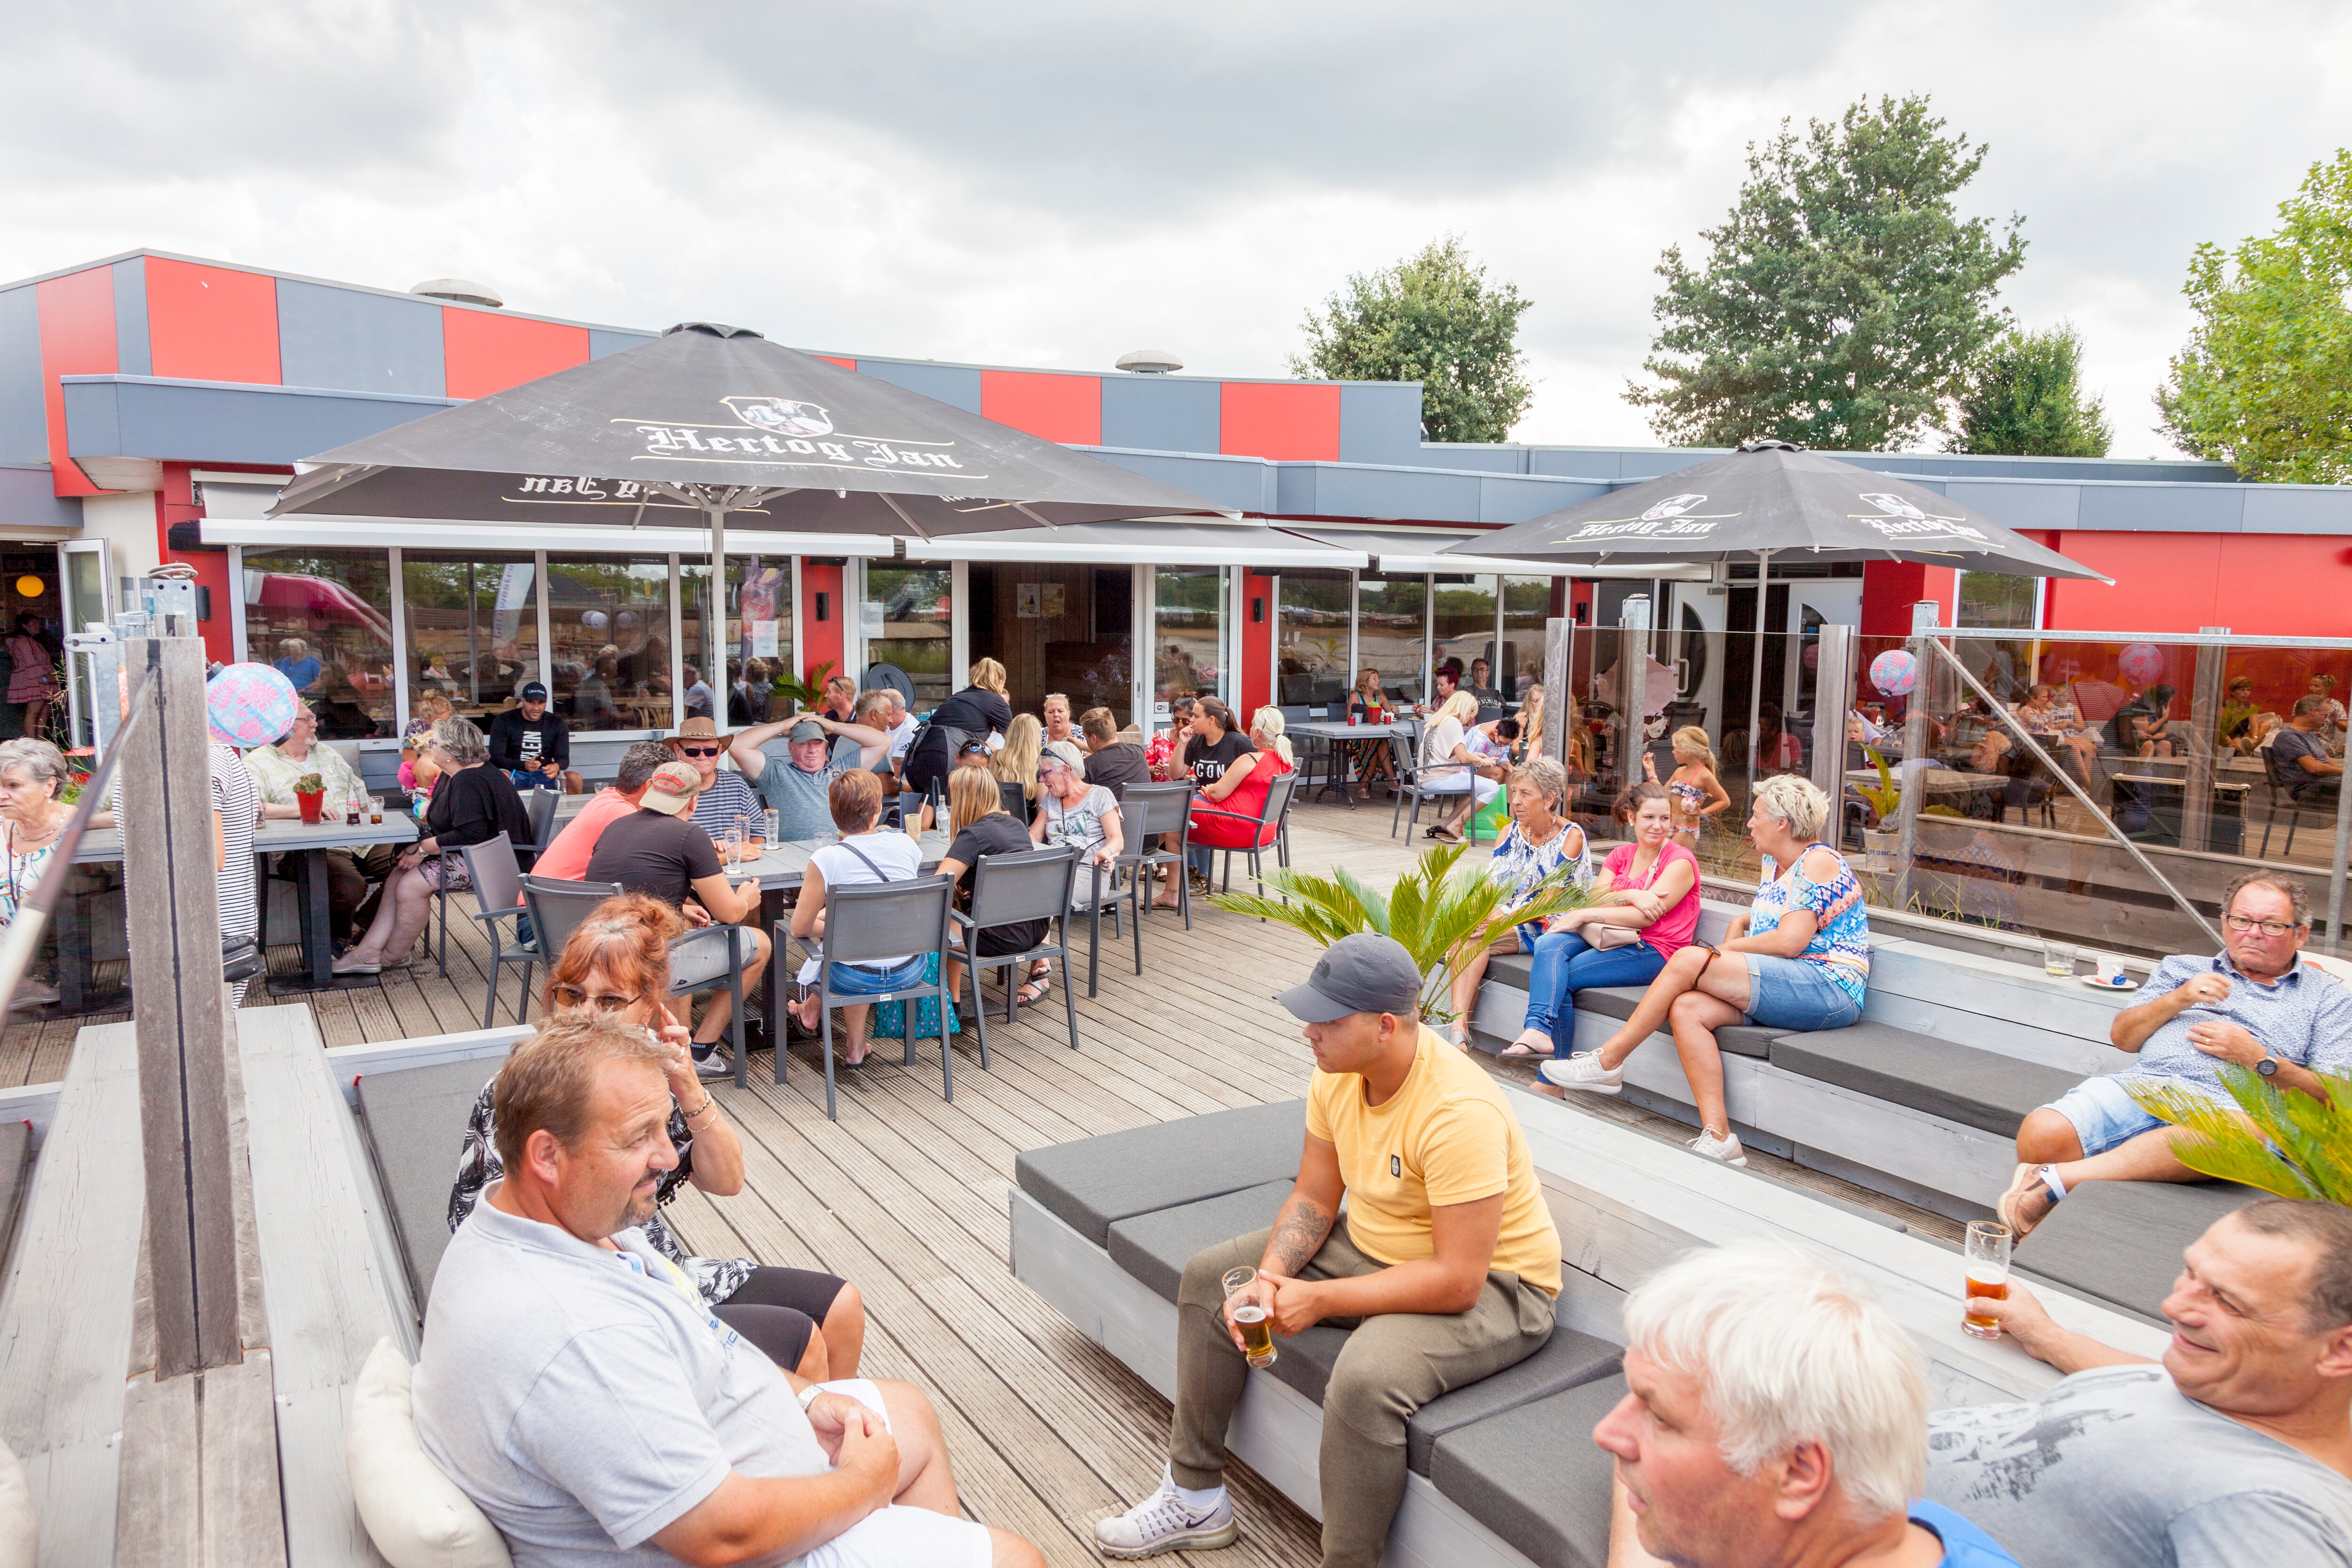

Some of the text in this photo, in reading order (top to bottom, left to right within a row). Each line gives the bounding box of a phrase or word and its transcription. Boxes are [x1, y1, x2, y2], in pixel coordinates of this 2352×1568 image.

[636, 425, 963, 469] Hertog Jan
[1565, 518, 1718, 541] Hertog Jan
[1478, 698, 1502, 707] PREMIUM
